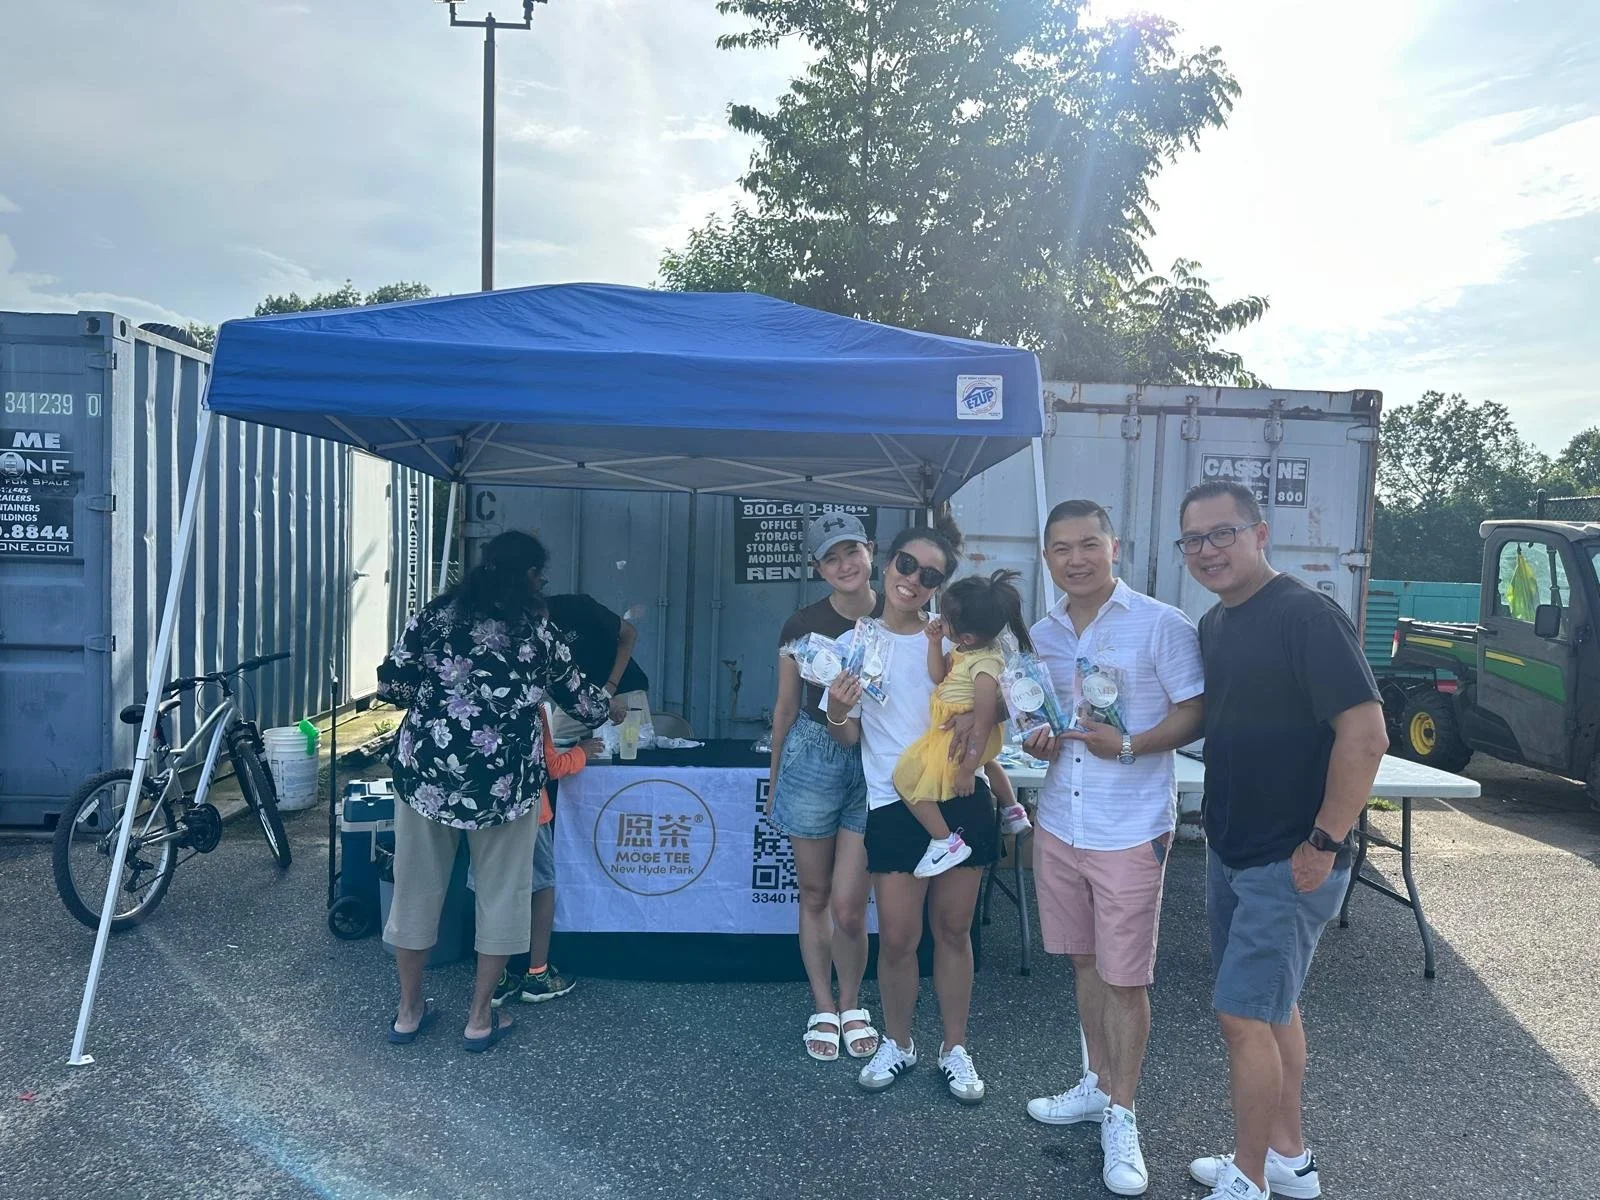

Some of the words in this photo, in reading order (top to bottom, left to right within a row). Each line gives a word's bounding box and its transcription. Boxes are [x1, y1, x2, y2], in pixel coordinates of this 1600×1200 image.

[5, 392, 73, 415] 341239
[12, 431, 61, 449] ME
[760, 520, 798, 530] OFFICE
[0, 524, 69, 540] .8844
[754, 531, 804, 541] STORAGE
[746, 543, 796, 553] STORAGE
[748, 553, 802, 564] MODULAR
[664, 852, 690, 864] TEE
[611, 865, 635, 874] New
[638, 865, 667, 876] Hyde
[669, 865, 694, 875] Park
[751, 893, 787, 904] 3340
